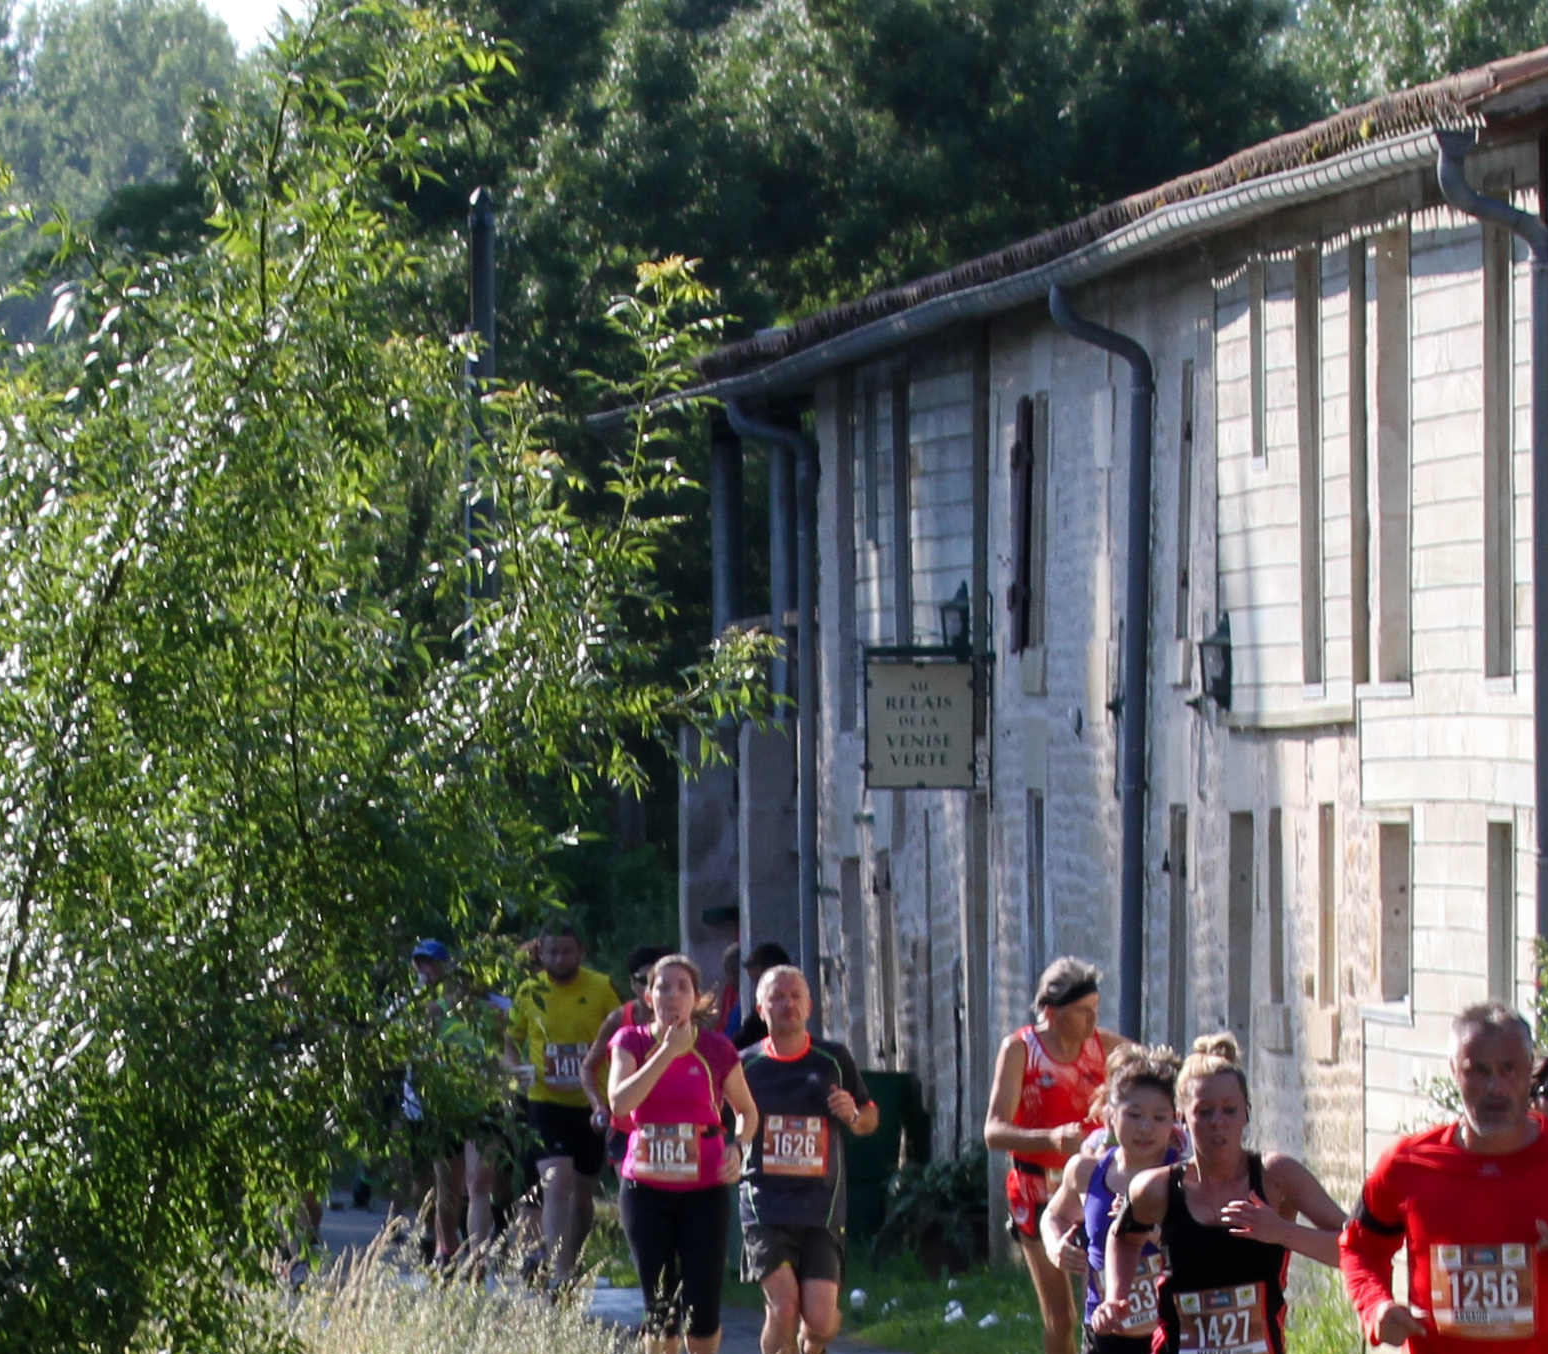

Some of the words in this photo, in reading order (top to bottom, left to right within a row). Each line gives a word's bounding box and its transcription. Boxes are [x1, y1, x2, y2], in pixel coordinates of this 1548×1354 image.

[910, 682, 929, 691] AU
[886, 696, 952, 710] RELAIS
[899, 716, 914, 726] DE
[920, 716, 939, 726] LA
[886, 733, 951, 747] VENISE
[890, 753, 947, 766] VERTE
[648, 1139, 687, 1164] 1164
[773, 1132, 816, 1157] 1626
[1449, 1270, 1519, 1309] 1256
[1194, 1310, 1250, 1348] 1427
